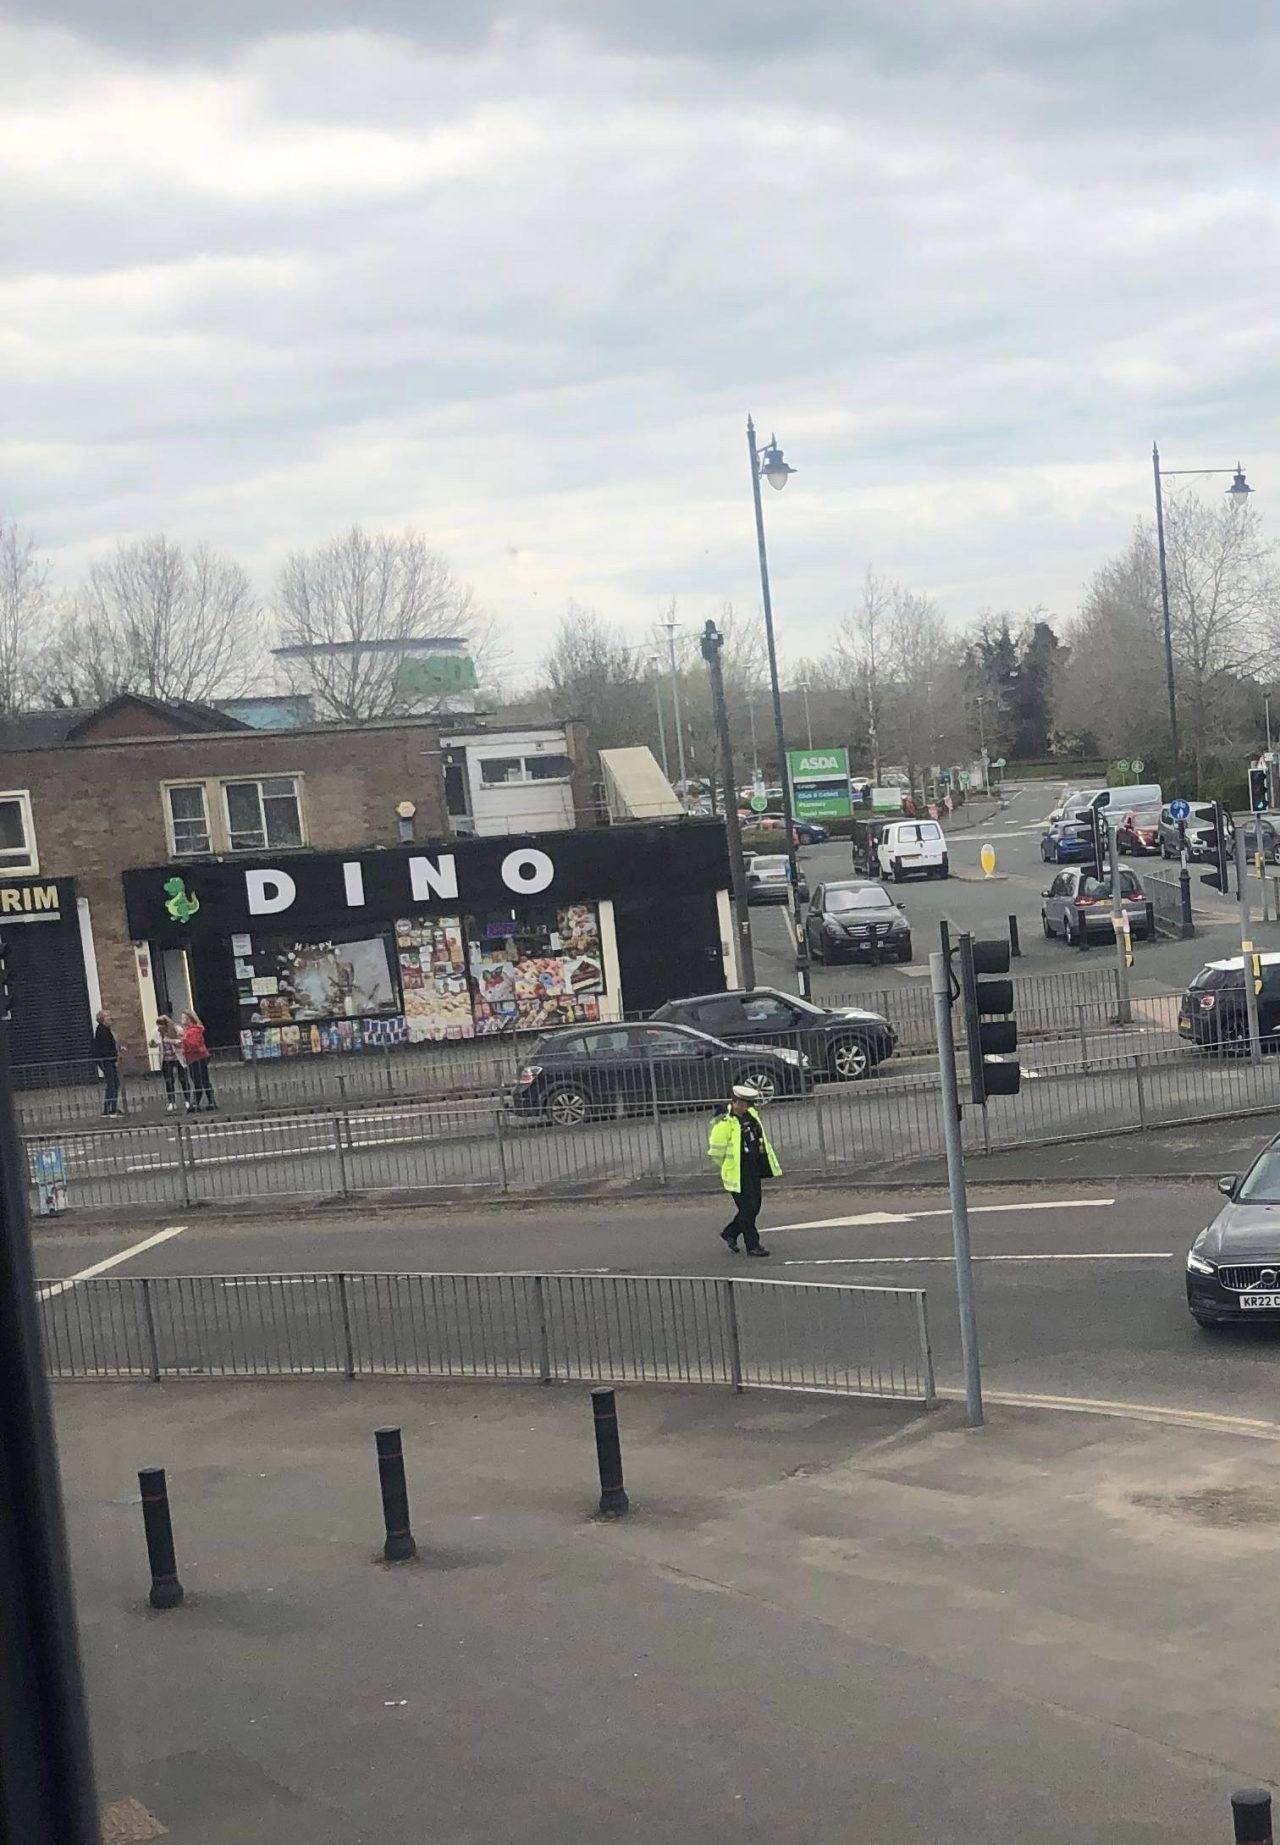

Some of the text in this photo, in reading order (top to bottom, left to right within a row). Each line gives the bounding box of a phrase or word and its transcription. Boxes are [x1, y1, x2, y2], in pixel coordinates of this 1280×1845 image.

[799, 756, 839, 771] ASDA
[245, 848, 554, 915] DINO
[294, 941, 332, 951] HPY
[1243, 1296, 1271, 1307] KR22
